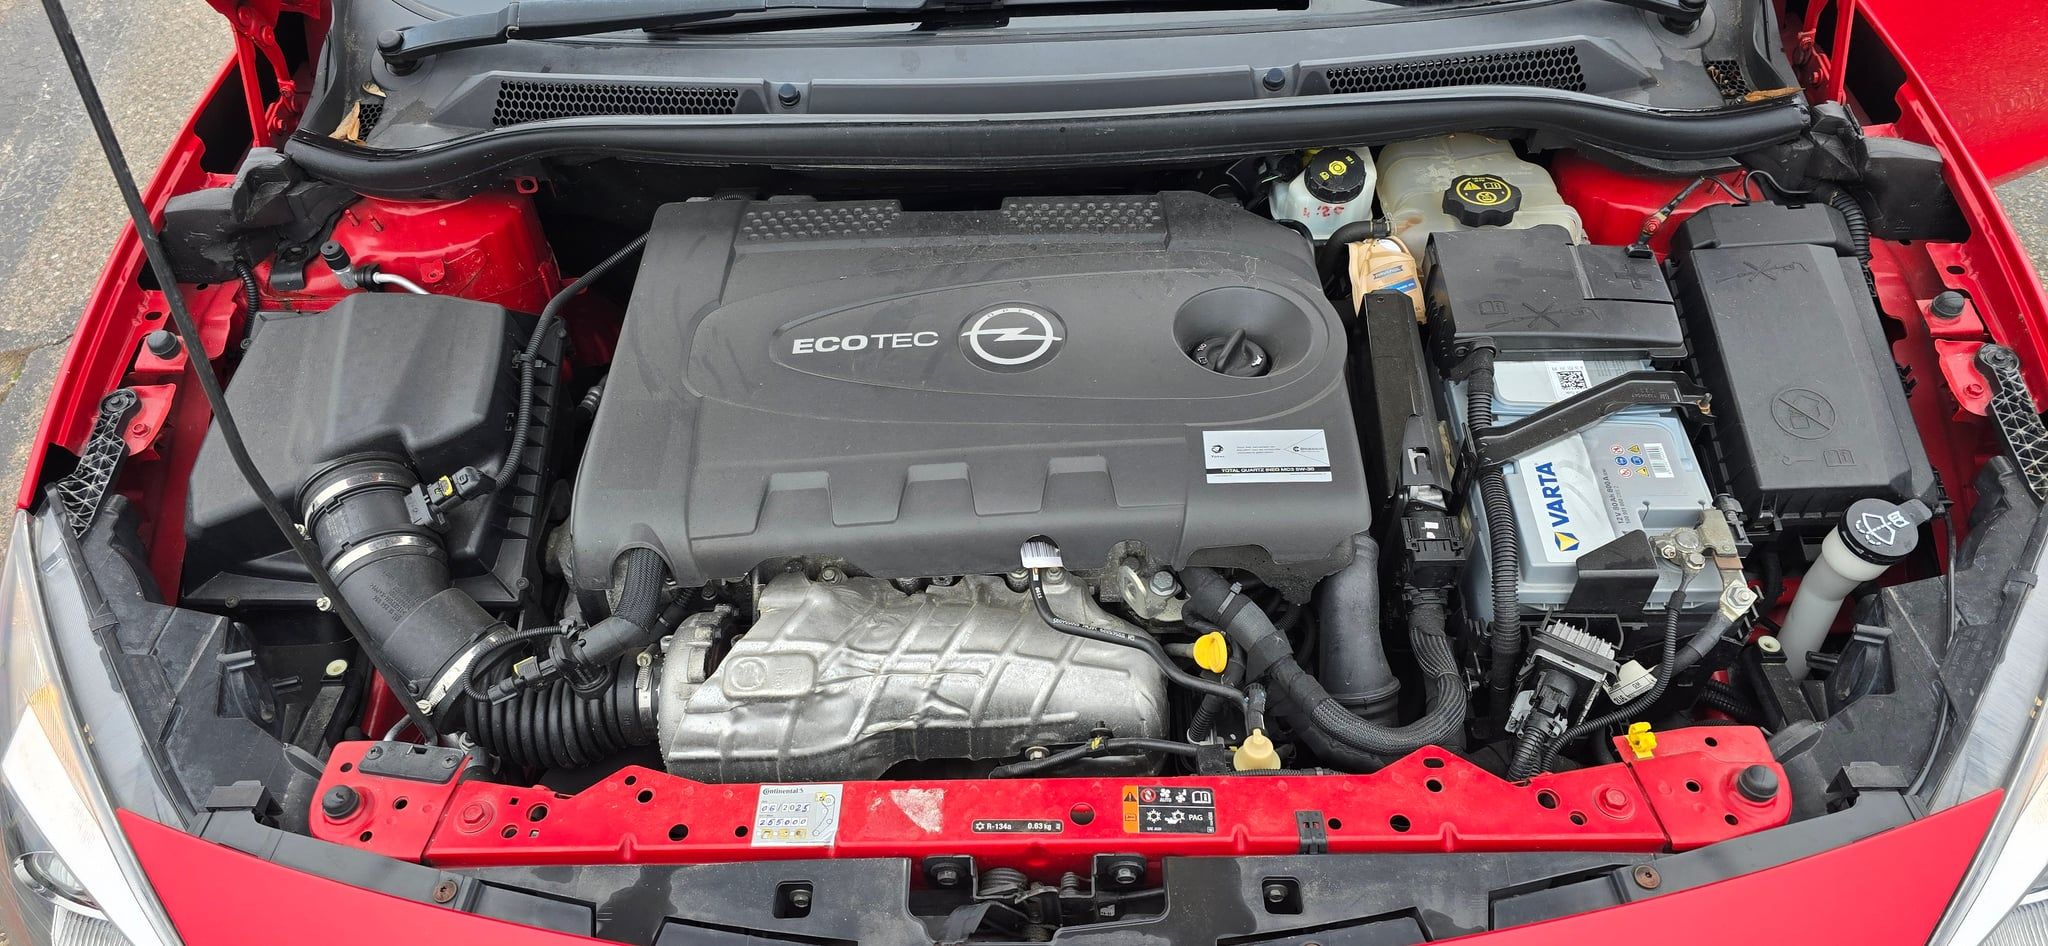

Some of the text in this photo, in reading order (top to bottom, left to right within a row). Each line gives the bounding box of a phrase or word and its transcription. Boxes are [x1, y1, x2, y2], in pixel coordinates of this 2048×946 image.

[792, 331, 939, 354] ECOTEC
[1535, 462, 1570, 528] VARTA
[1614, 511, 1625, 524] 12V
[762, 787, 799, 796] Continental
[1044, 823, 1052, 831] kg
